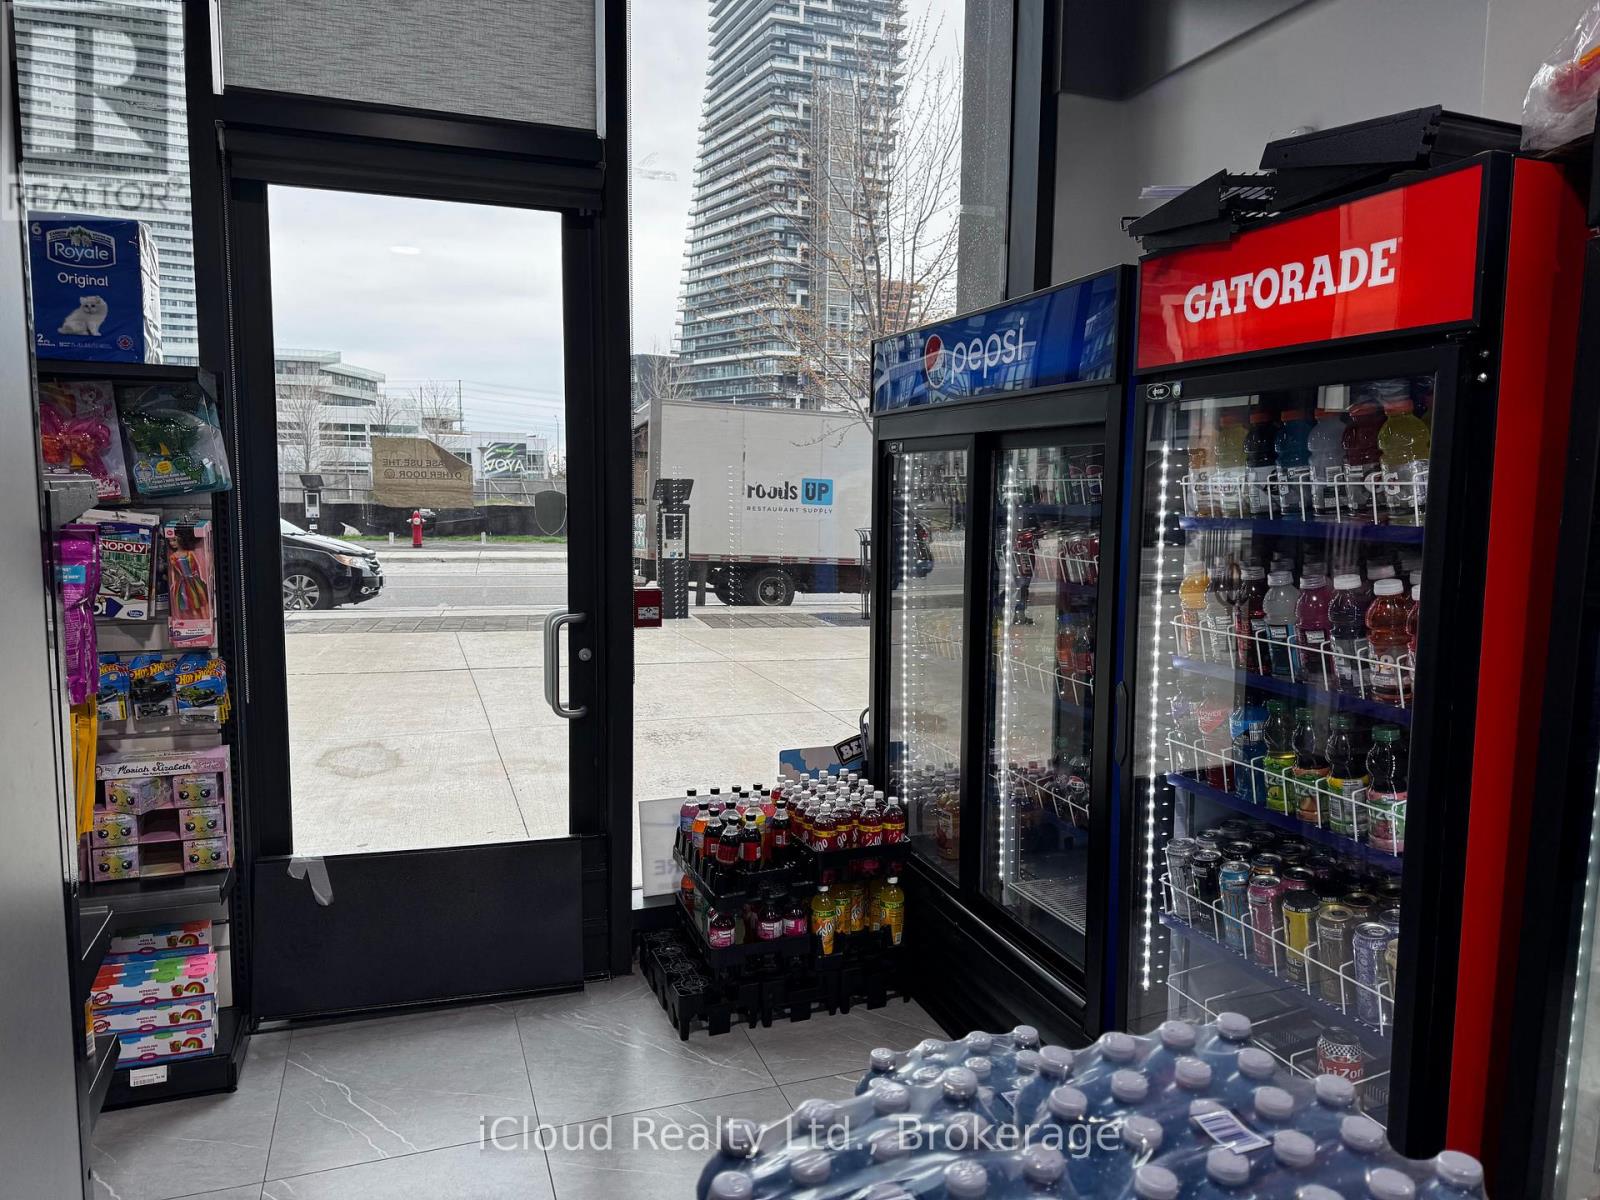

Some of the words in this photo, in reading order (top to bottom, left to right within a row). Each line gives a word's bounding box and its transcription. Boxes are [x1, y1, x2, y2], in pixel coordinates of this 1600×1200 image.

[31, 222, 42, 235] 6
[54, 242, 109, 262] Royale
[57, 272, 109, 288] Original
[1183, 237, 1398, 323] GATORADE
[951, 316, 1025, 385] pepsi
[805, 482, 830, 502] UP
[102, 541, 145, 553] NOPOLY
